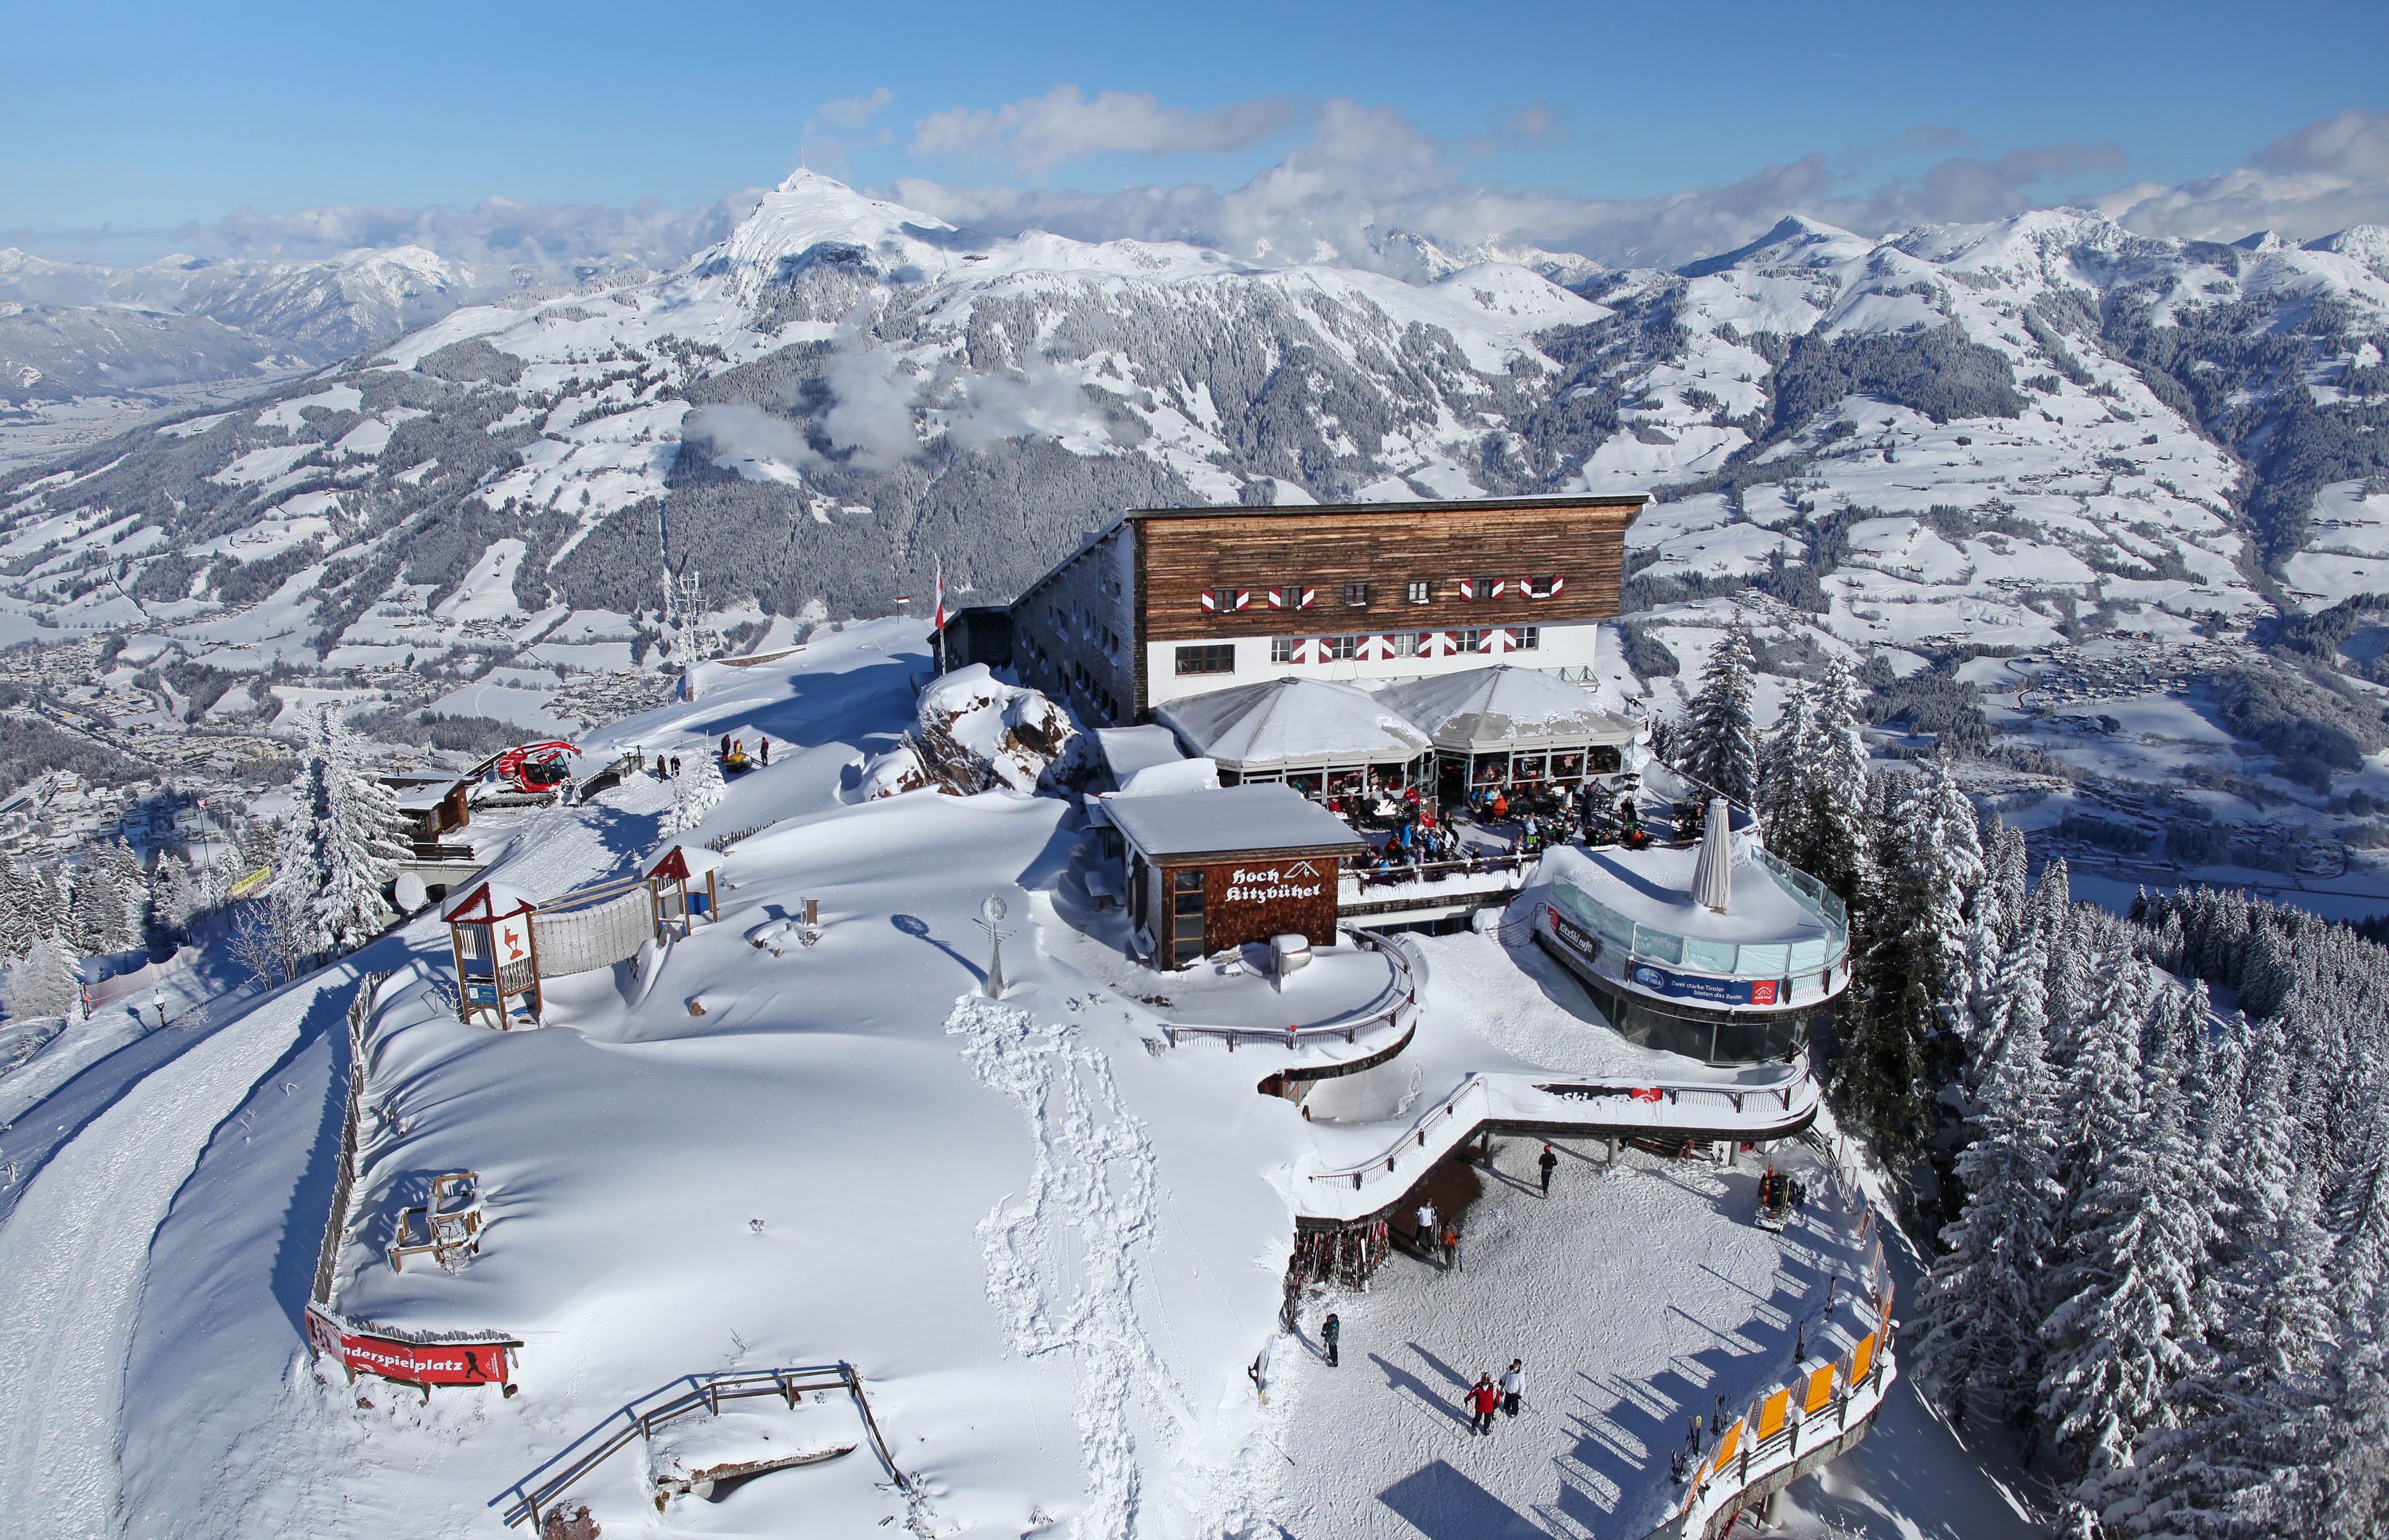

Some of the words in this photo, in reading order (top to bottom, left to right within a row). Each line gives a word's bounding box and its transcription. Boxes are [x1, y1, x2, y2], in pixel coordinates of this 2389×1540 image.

[1232, 868, 1279, 885] Hoch
[1225, 884, 1321, 904] Kitzbühel
[1558, 923, 1581, 944] KitzSki
[1687, 982, 1705, 991] starke
[342, 1346, 463, 1374] nderspielplatz
